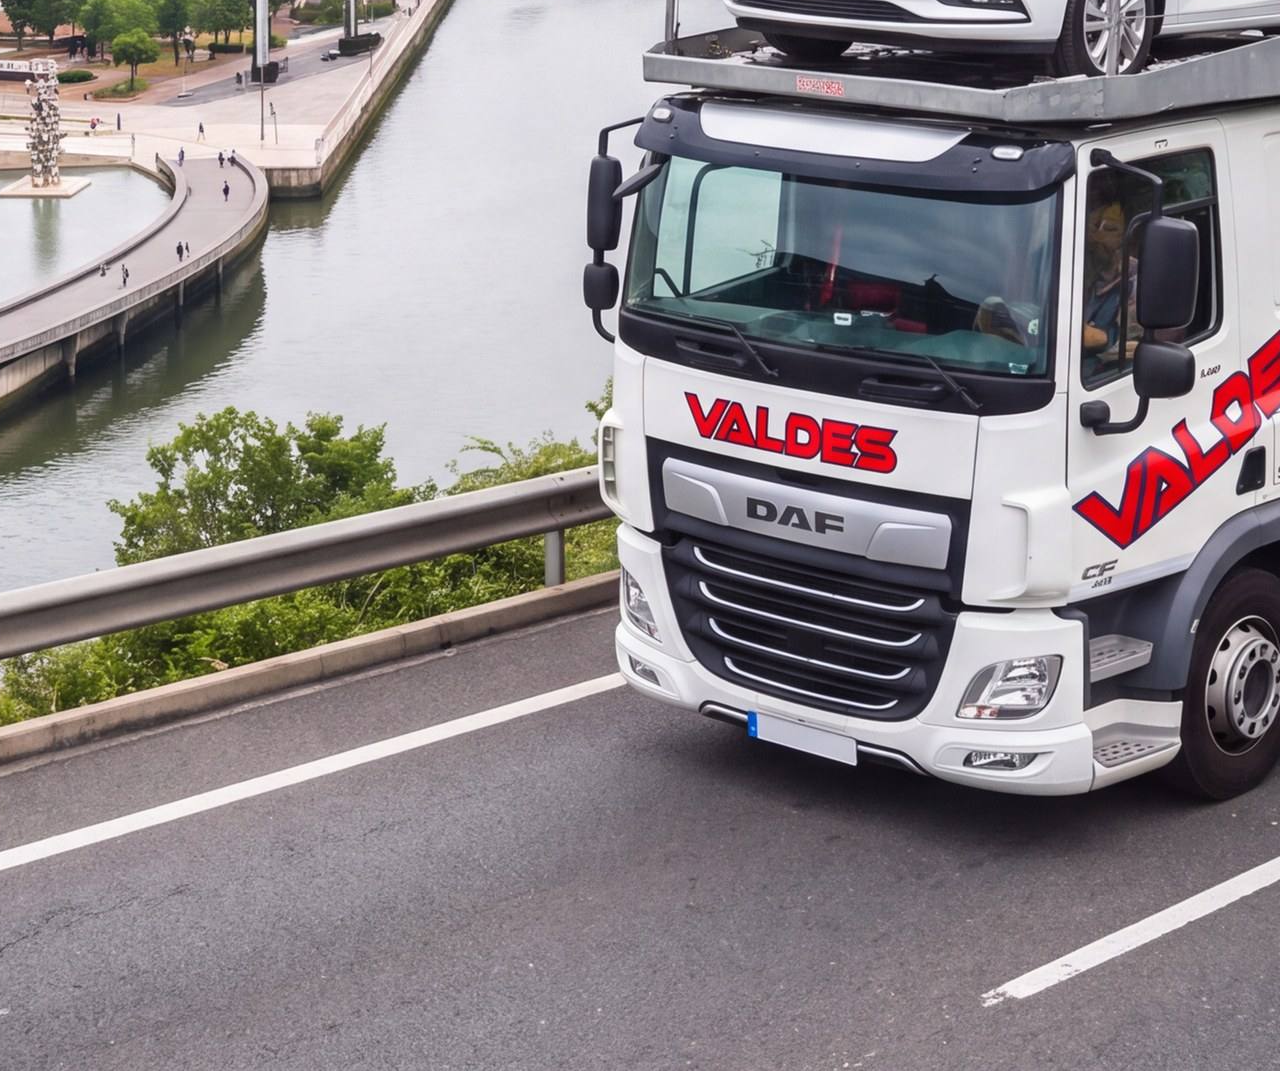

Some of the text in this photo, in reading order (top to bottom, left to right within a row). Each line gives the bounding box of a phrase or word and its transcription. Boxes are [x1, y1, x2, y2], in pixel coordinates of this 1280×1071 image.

[684, 391, 899, 474] VALDES
[746, 496, 845, 535] DAF
[1081, 559, 1119, 580] CF
